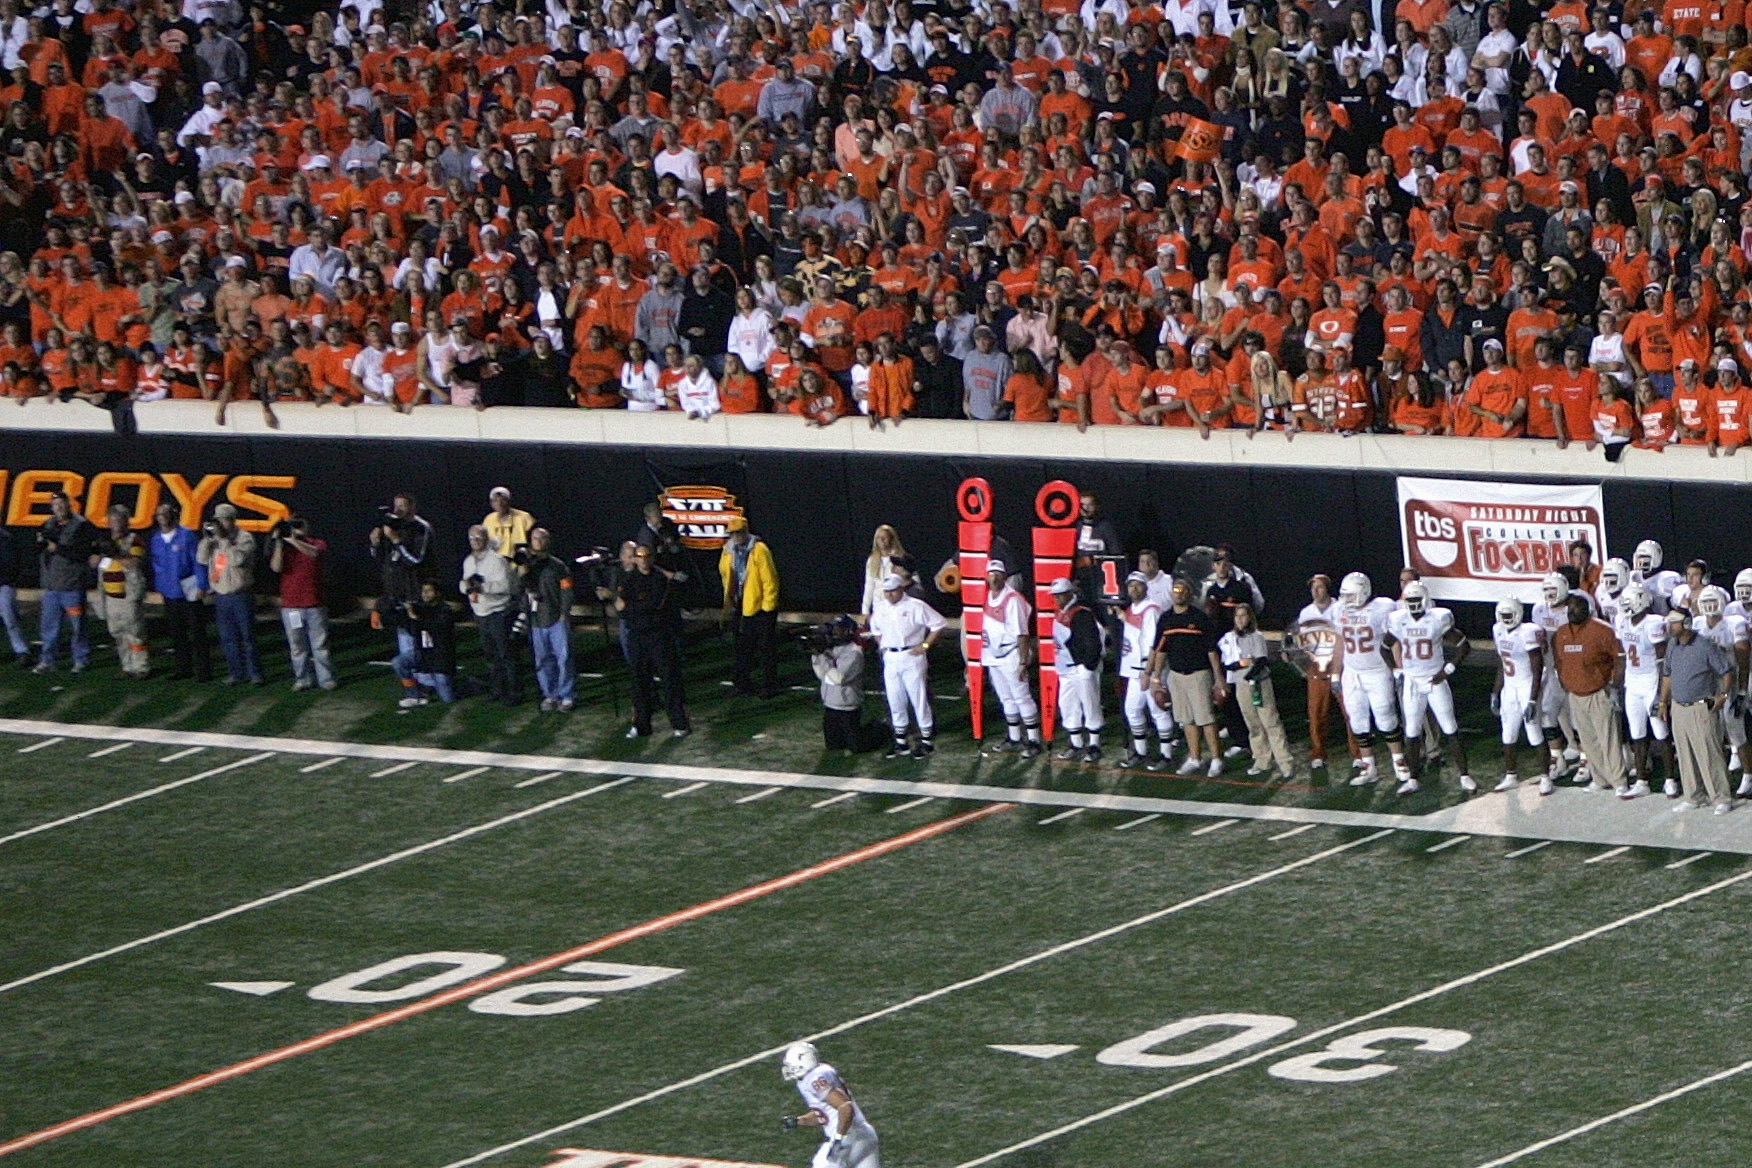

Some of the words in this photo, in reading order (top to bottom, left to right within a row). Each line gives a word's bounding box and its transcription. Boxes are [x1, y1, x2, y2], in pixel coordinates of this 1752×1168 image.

[0, 470, 297, 533] BOYS
[1470, 506, 1539, 521] SATURDAY
[1545, 509, 1588, 522] NIGHT
[1413, 510, 1457, 540] tbs
[1486, 527, 1575, 539] COLLEGE
[1101, 561, 1119, 595] 1
[1406, 628, 1427, 637] TEXAS
[1403, 638, 1433, 660] 10
[306, 950, 686, 1017] 20
[1095, 1012, 1472, 1083] 30
